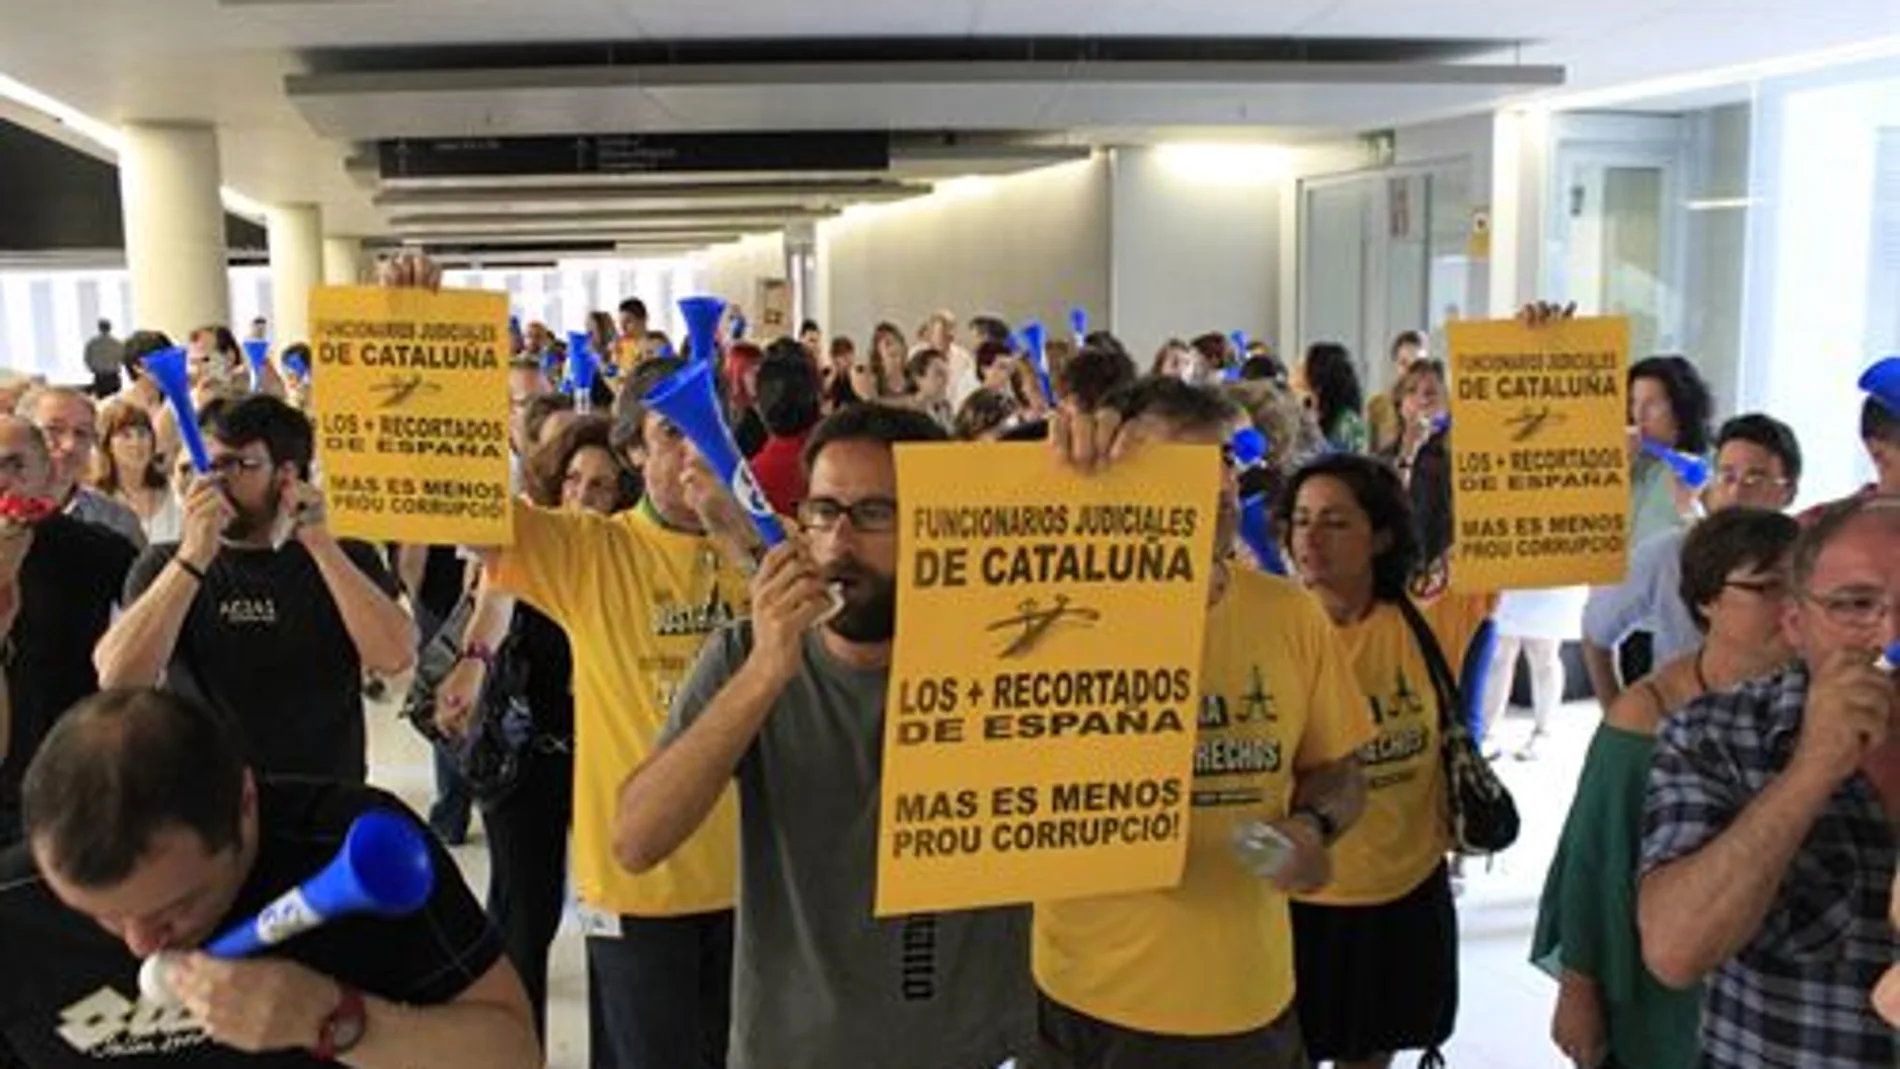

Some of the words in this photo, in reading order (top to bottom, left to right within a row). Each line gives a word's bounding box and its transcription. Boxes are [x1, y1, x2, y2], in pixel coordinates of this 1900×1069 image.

[319, 342, 352, 366] DE
[360, 341, 499, 369] CATALUÑA
[1458, 376, 1490, 400] DE
[1496, 370, 1619, 399] CATALUÑA
[323, 413, 357, 435] LOS
[379, 415, 504, 441] RECORTADOS
[326, 437, 366, 453] DE
[376, 438, 502, 457] ESPAÑA
[1458, 452, 1491, 473] LOS
[1510, 448, 1624, 472] RECORTADOS
[329, 475, 379, 493] MAS
[387, 478, 416, 496] ES
[423, 480, 506, 500] MENOS
[1459, 474, 1498, 491] DE
[1507, 470, 1623, 491] ESPAÑA
[914, 504, 1069, 540] FUNCIONARIOS
[1074, 505, 1198, 537] JUDICIALES
[1461, 518, 1510, 538] MAS
[1515, 516, 1543, 536] ES
[1549, 514, 1625, 534] MENOS
[913, 547, 969, 588] DE
[981, 534, 1194, 587] CATALUÑA
[899, 676, 959, 715] LOS
[968, 680, 984, 706] +
[994, 668, 1191, 710] RECORTADOS
[897, 718, 965, 746] DE
[984, 701, 1184, 740] ESPAÑA
[1193, 737, 1282, 776] RECHOS
[895, 790, 979, 824] MAS
[992, 786, 1039, 817] ES
[1052, 778, 1182, 813] MENOS
[893, 824, 983, 860] PROU
